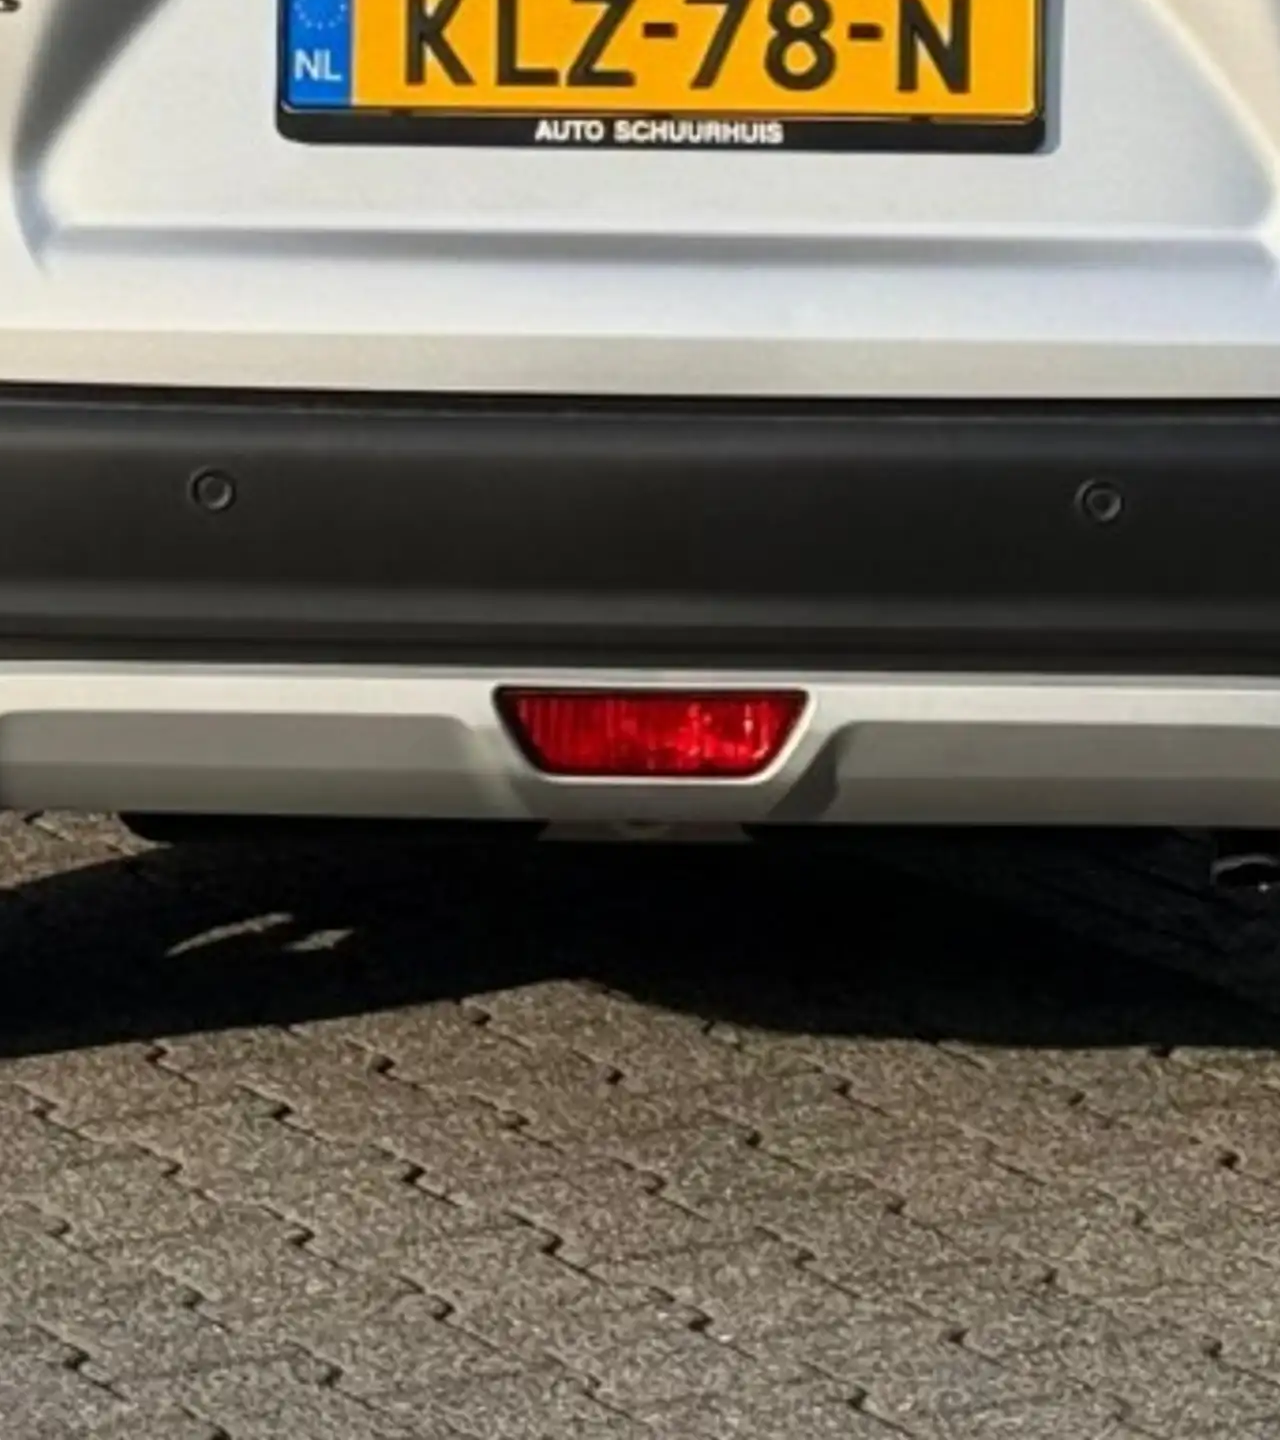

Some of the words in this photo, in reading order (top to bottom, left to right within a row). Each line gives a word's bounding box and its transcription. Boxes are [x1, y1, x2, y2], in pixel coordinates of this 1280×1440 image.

[295, 49, 342, 81] NL
[535, 120, 604, 142] AUTO
[614, 120, 784, 144] SCHUURHUIS
